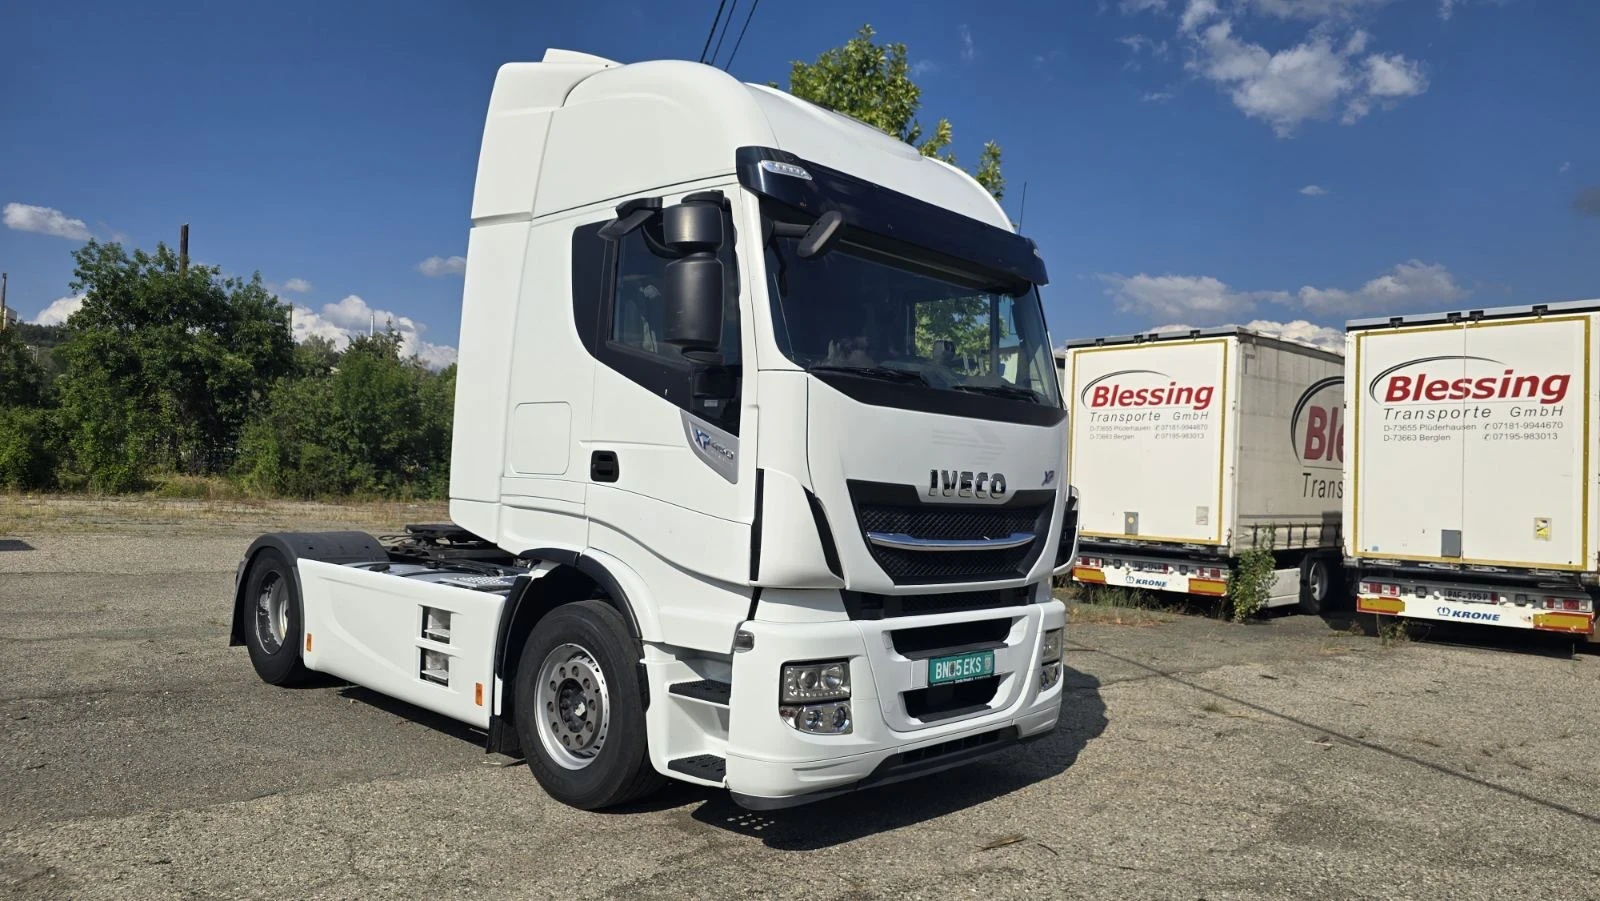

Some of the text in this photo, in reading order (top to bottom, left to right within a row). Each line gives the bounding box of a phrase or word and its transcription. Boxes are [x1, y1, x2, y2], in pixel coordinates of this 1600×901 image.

[1384, 369, 1571, 405] Blessing
[1091, 381, 1214, 410] Blessing
[1090, 411, 1209, 424] Transporte GmbH
[1383, 405, 1564, 422] Transporte GmbH
[1384, 421, 1564, 432] D-73655 Plüderhausen 07181-9944670
[1493, 432, 1558, 441] 07195-983013
[928, 469, 1007, 500] IVECO
[1135, 578, 1168, 588] KRONE
[1451, 609, 1501, 622] KRONE
